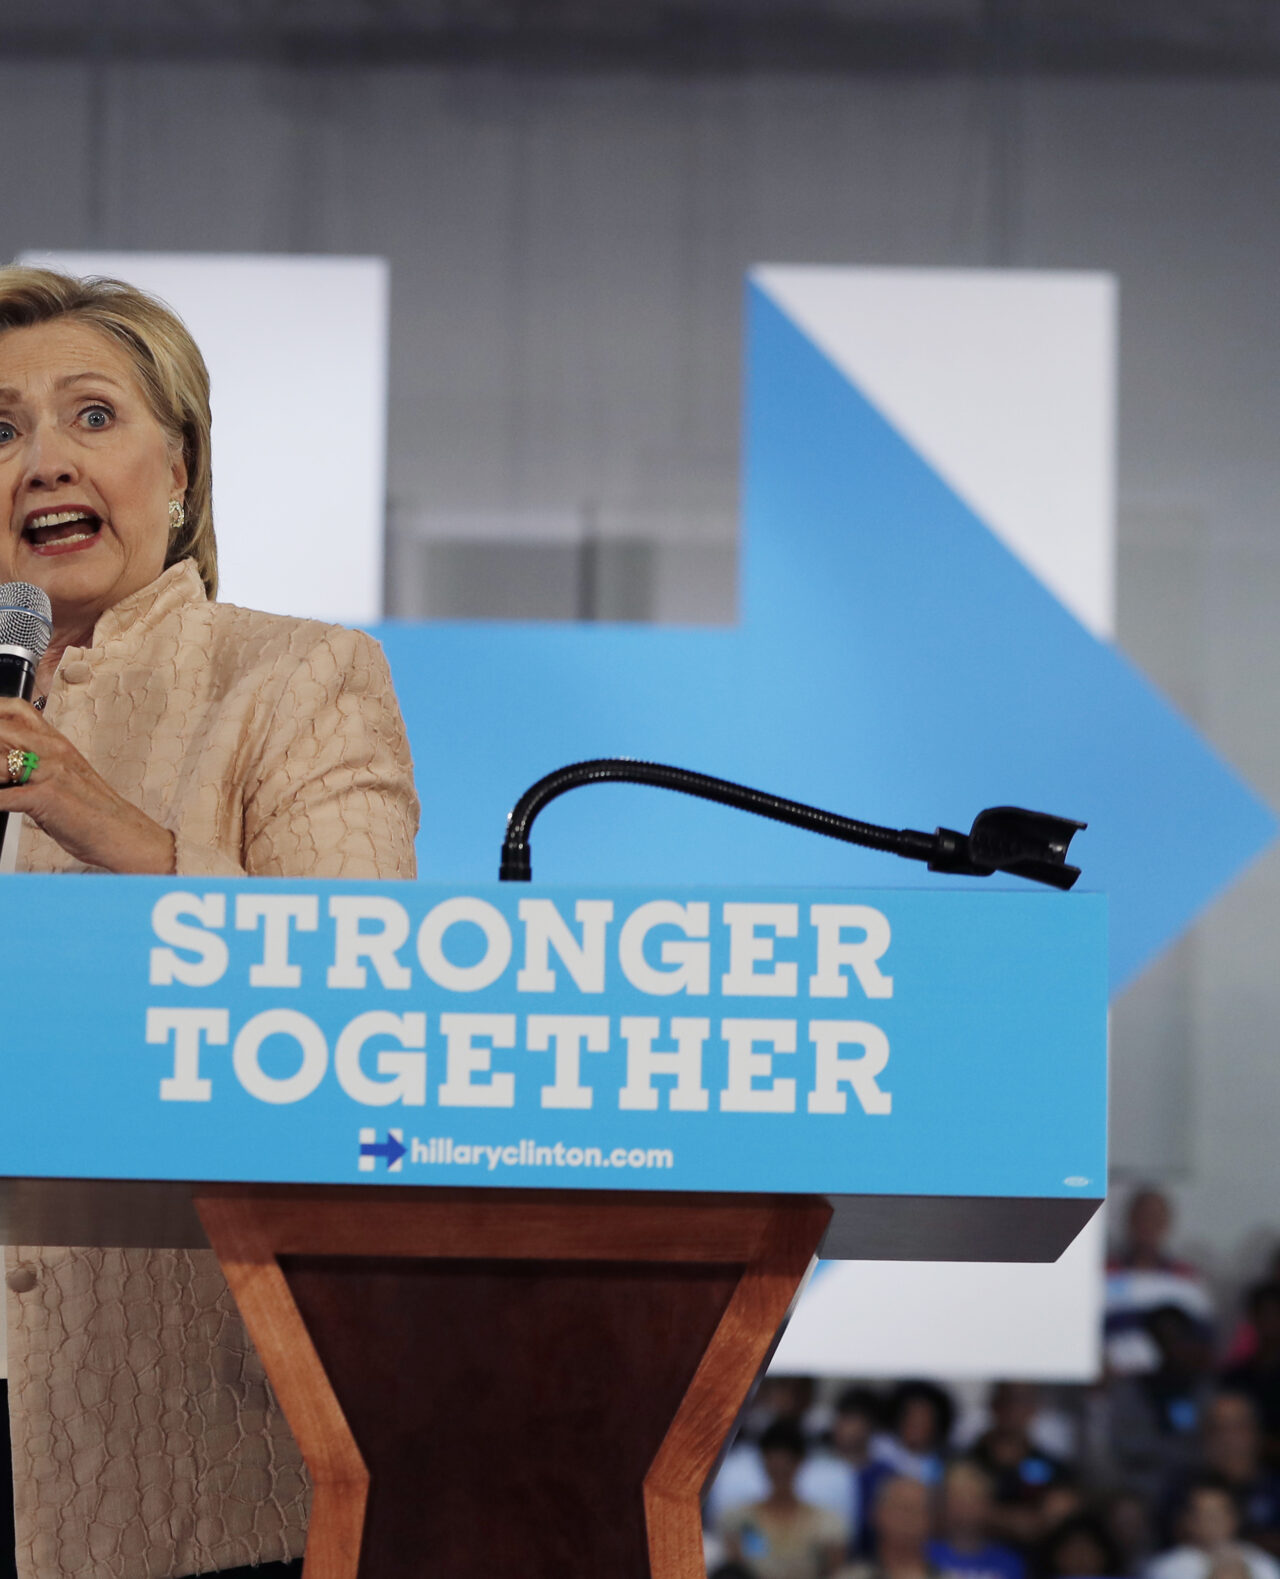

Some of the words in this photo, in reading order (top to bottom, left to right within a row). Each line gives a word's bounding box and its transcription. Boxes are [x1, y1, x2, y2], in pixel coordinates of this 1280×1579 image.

[149, 891, 894, 999] STRONGER
[145, 1007, 893, 1115] TOGETHER
[410, 1137, 675, 1171] hillaryclinton.com
